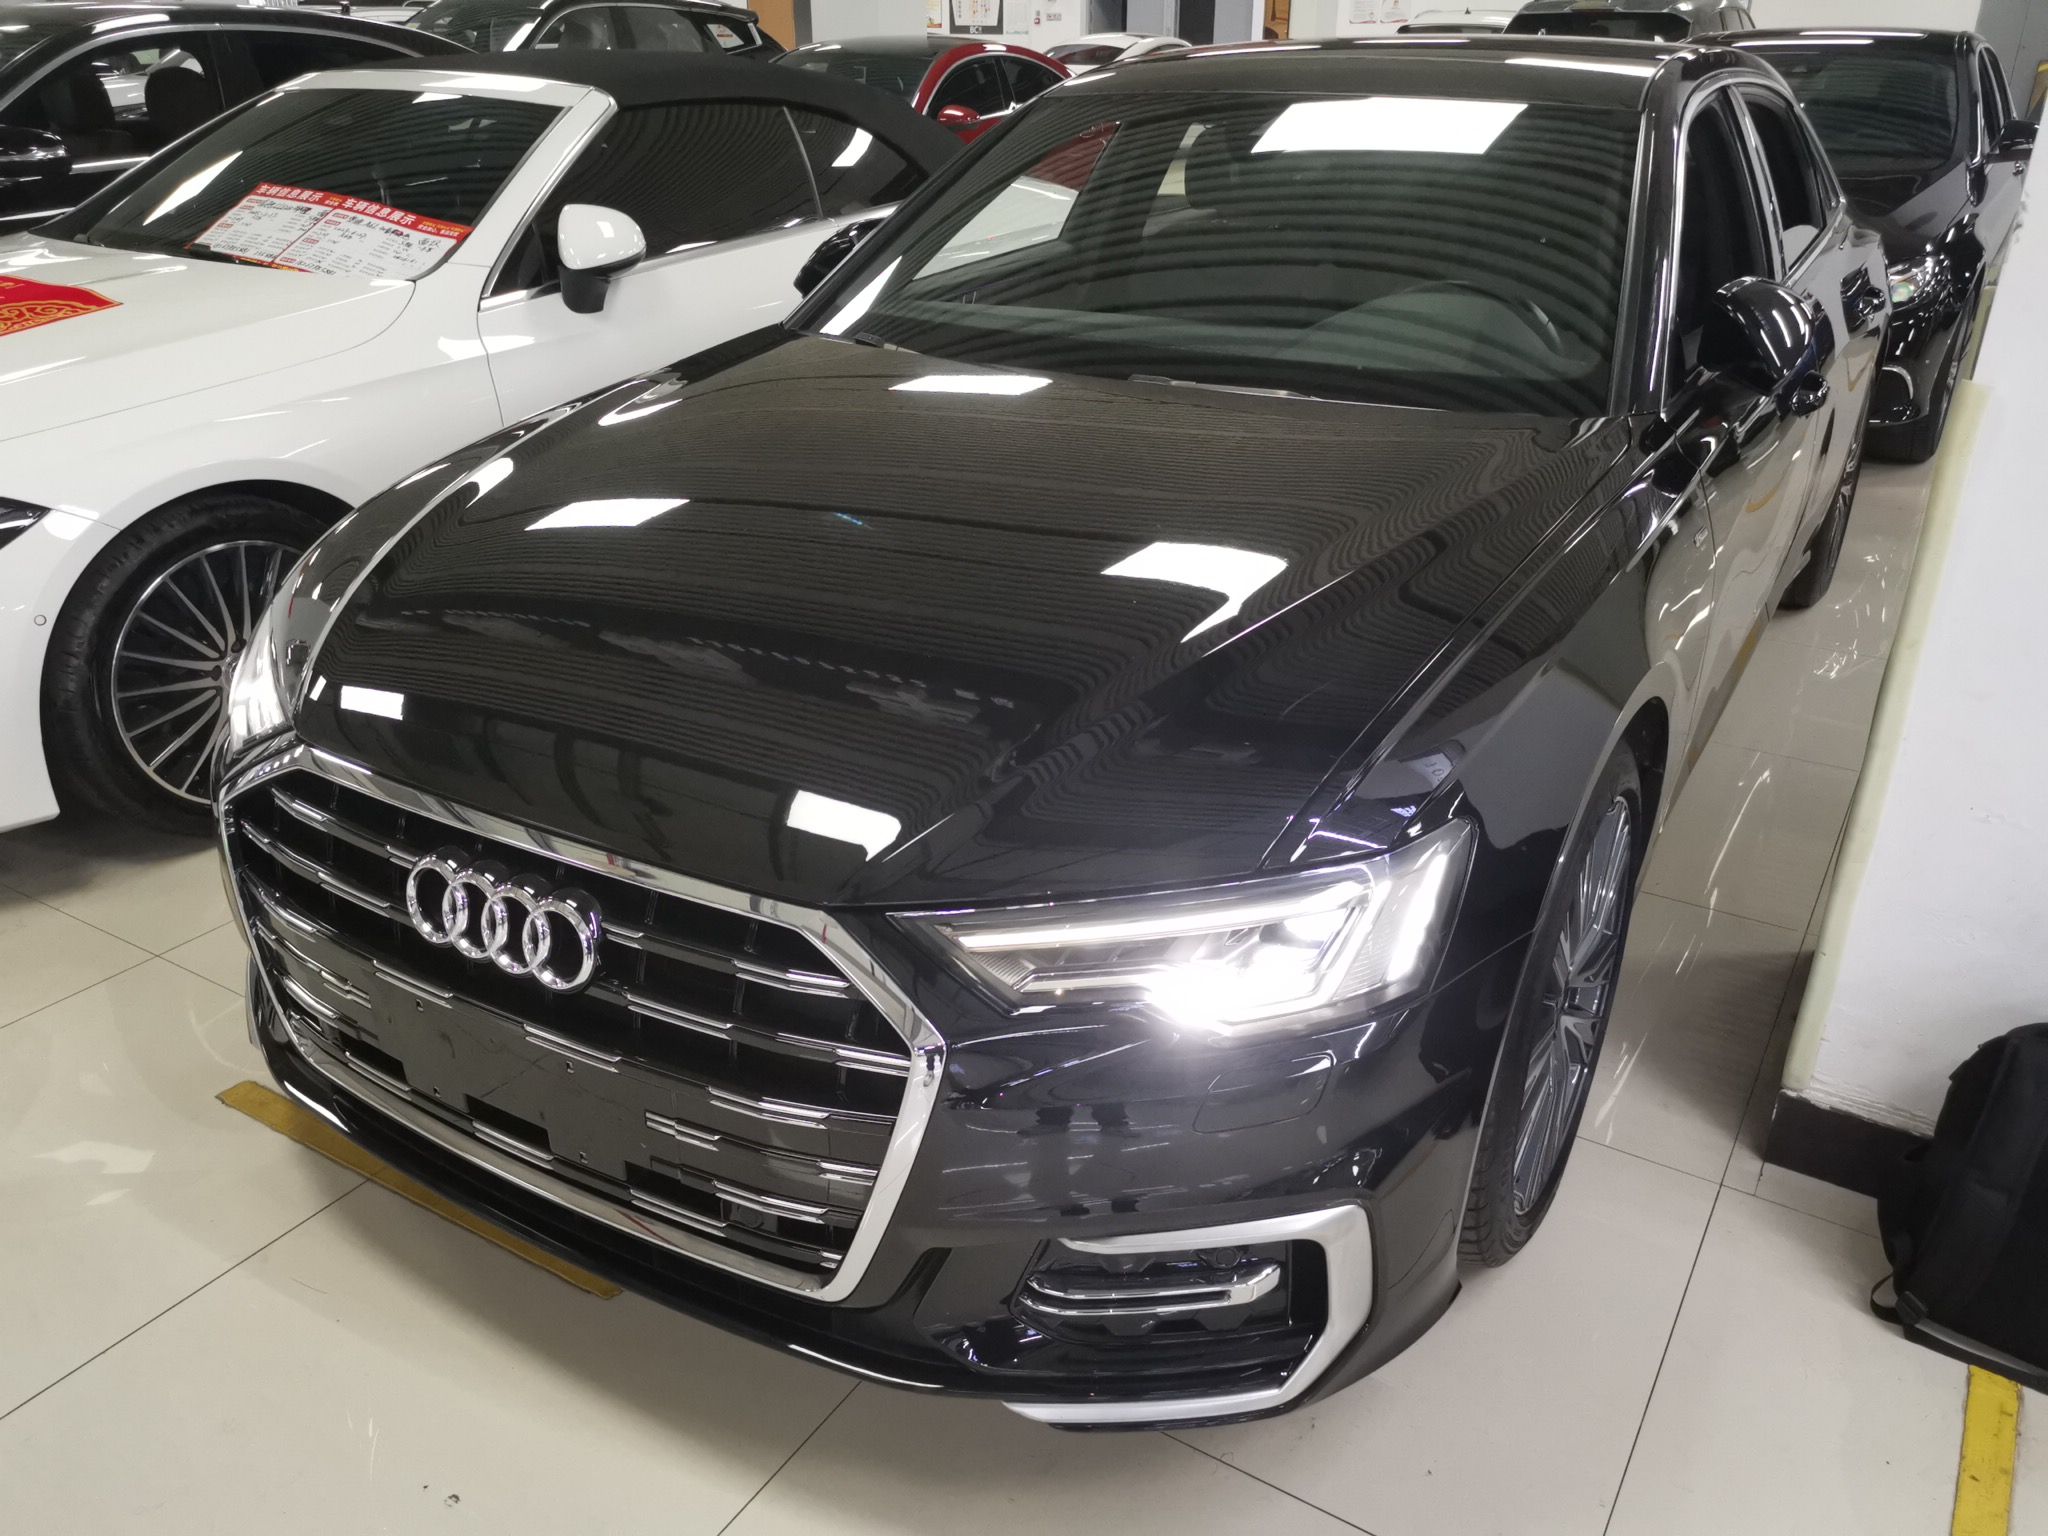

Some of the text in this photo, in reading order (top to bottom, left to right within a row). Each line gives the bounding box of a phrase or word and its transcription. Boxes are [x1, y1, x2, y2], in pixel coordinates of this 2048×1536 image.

[256, 184, 325, 201] 车辆信息展示
[342, 197, 417, 225] 车辆信息展示
